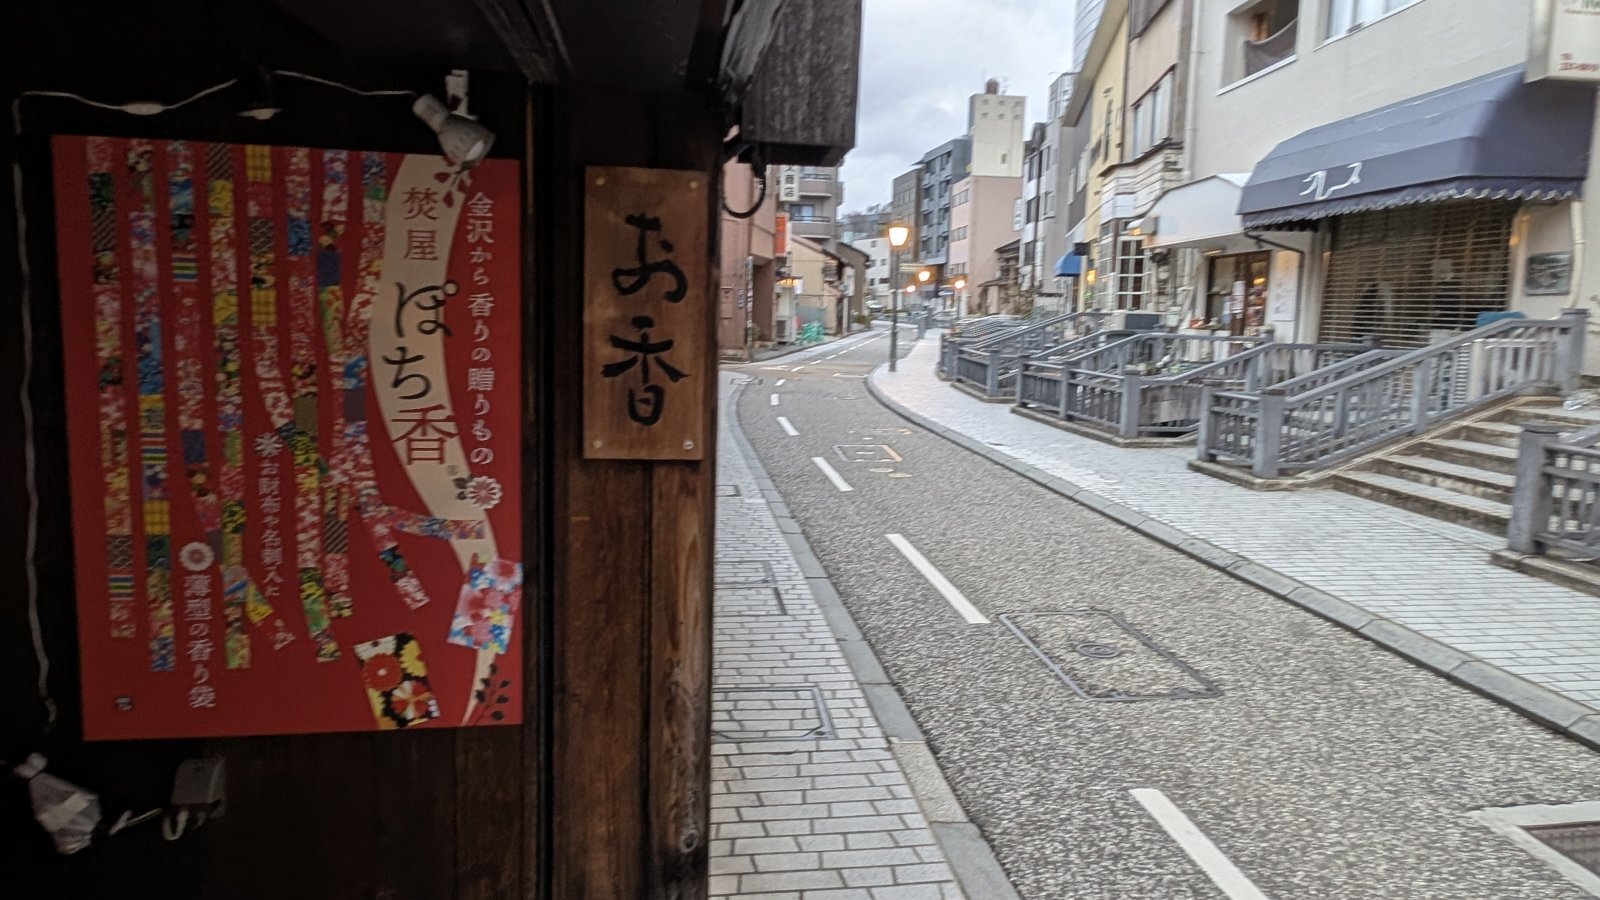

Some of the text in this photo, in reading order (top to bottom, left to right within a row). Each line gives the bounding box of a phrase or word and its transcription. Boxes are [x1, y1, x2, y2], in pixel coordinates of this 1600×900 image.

[402, 187, 439, 261] 焚屋
[381, 279, 460, 466] ぽち香
[466, 191, 497, 465] 金沢から香りの贈りもの
[601, 212, 690, 426] お香
[183, 575, 217, 709] 薄型の香り袋
